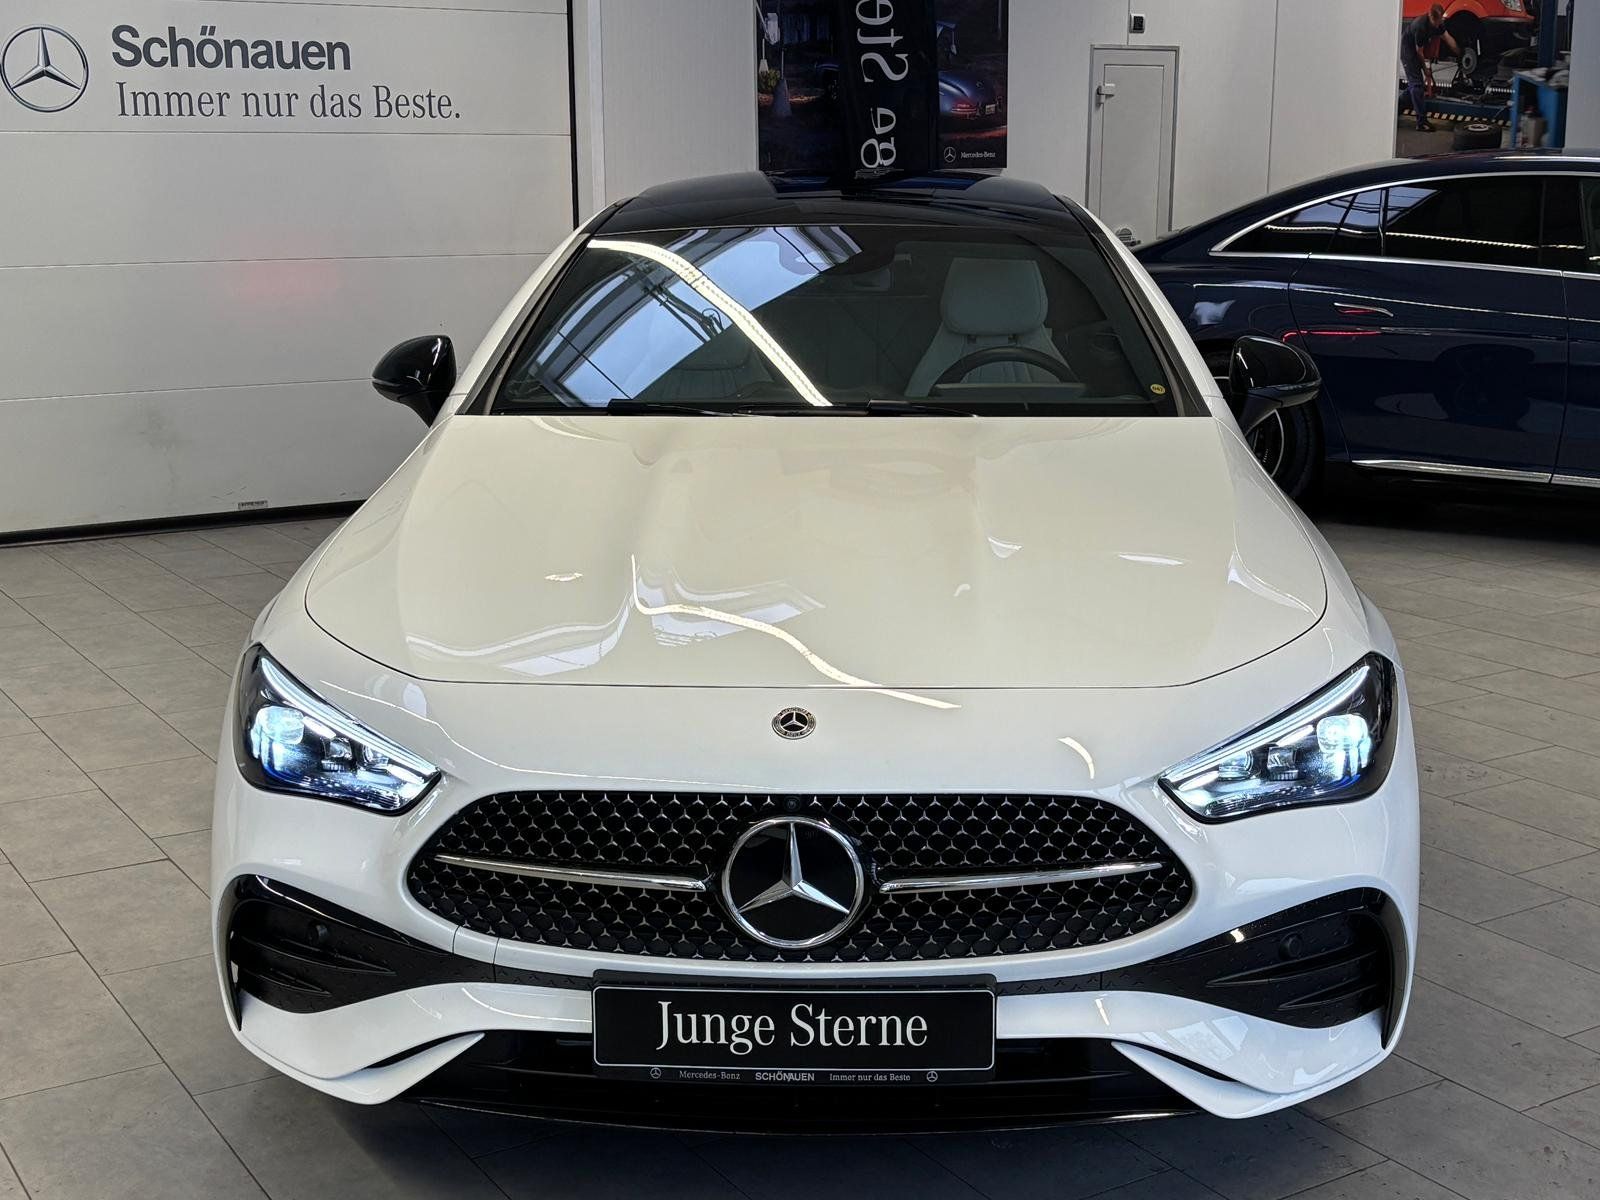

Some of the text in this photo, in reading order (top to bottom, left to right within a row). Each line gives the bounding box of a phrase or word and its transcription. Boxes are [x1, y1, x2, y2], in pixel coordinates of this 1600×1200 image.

[111, 24, 351, 71] Schönauen
[115, 81, 461, 119] Immer nur das Beste.
[656, 1001, 928, 1055] Junge Sterne
[679, 1070, 911, 1082] Mercedes-Benz SCHÖNAUEN Immer nur das Beste
